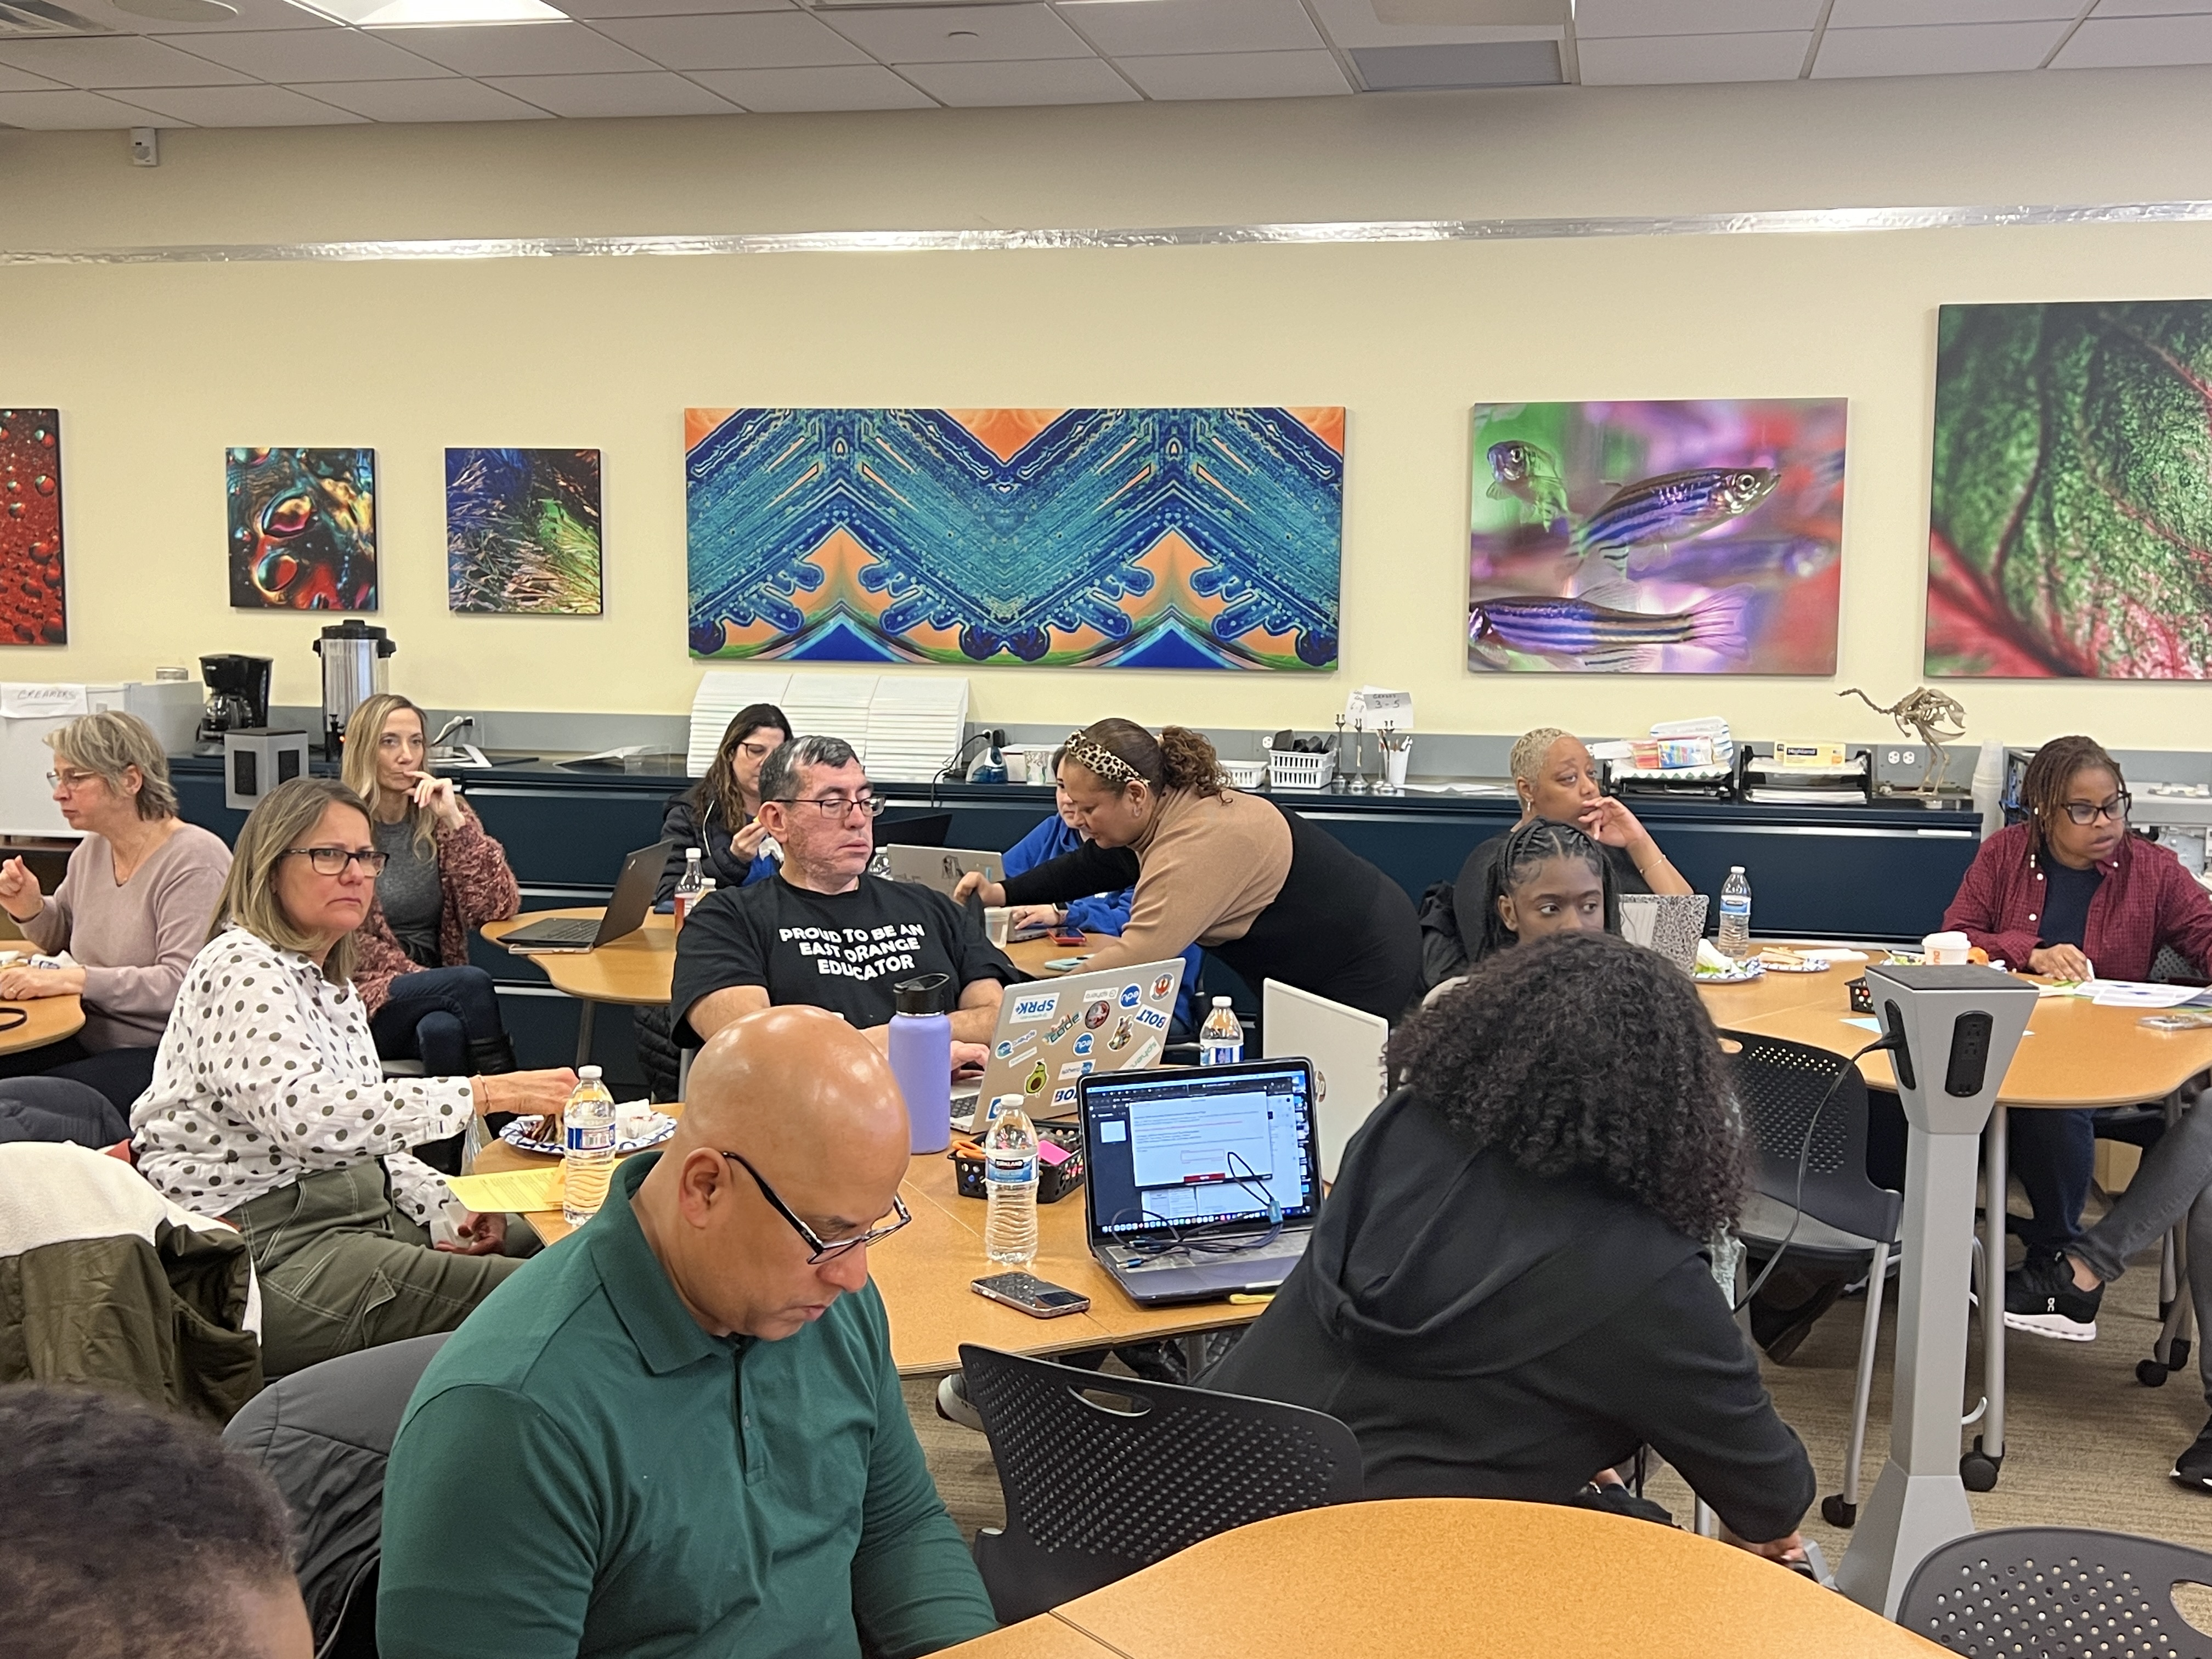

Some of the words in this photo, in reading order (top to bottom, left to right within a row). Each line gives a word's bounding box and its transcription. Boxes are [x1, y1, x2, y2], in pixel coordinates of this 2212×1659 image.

[779, 927, 842, 943] PROUD
[843, 929, 868, 943] TO
[871, 925, 897, 940] BE
[900, 924, 925, 936] AN
[799, 941, 840, 957] EAST
[843, 937, 921, 962] ORANGE
[817, 954, 915, 980] EDUCATOR
[1121, 991, 1139, 1002] edu
[1015, 1000, 1055, 1014] SPRK+
[1136, 1009, 1166, 1028] BOLT
